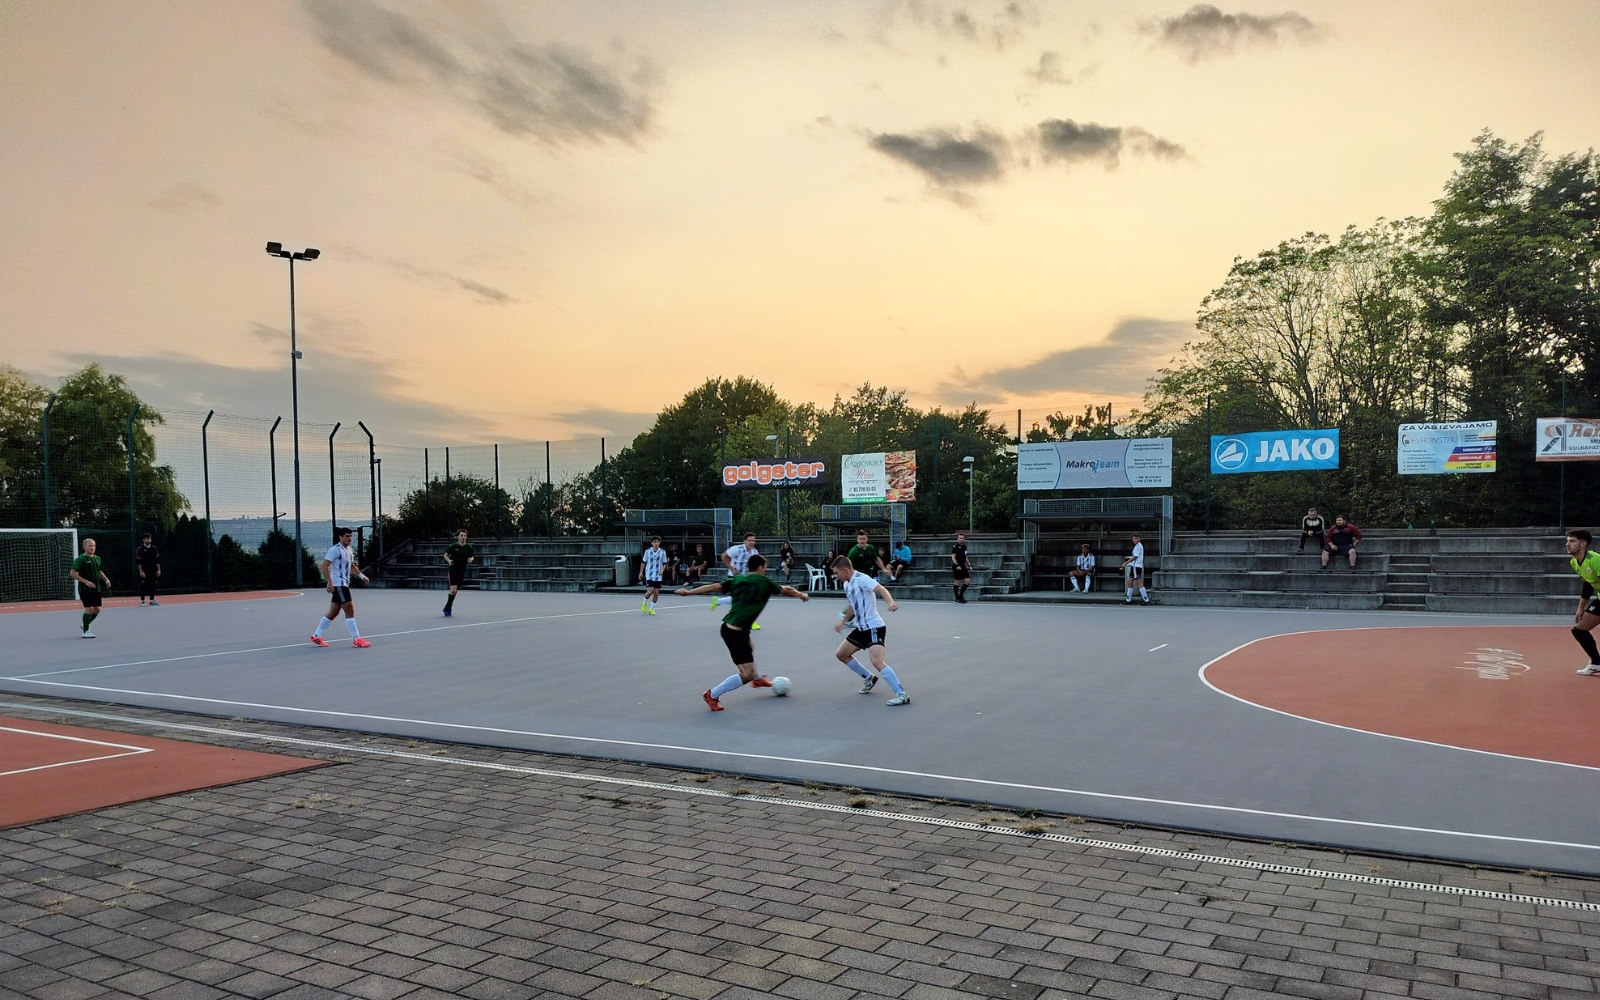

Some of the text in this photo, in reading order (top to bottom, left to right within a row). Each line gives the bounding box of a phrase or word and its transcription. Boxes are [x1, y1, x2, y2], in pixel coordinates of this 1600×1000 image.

[1439, 422, 1493, 430] IZVAJAMO
[1255, 437, 1335, 463] JAKO
[723, 461, 825, 486] golgeter
